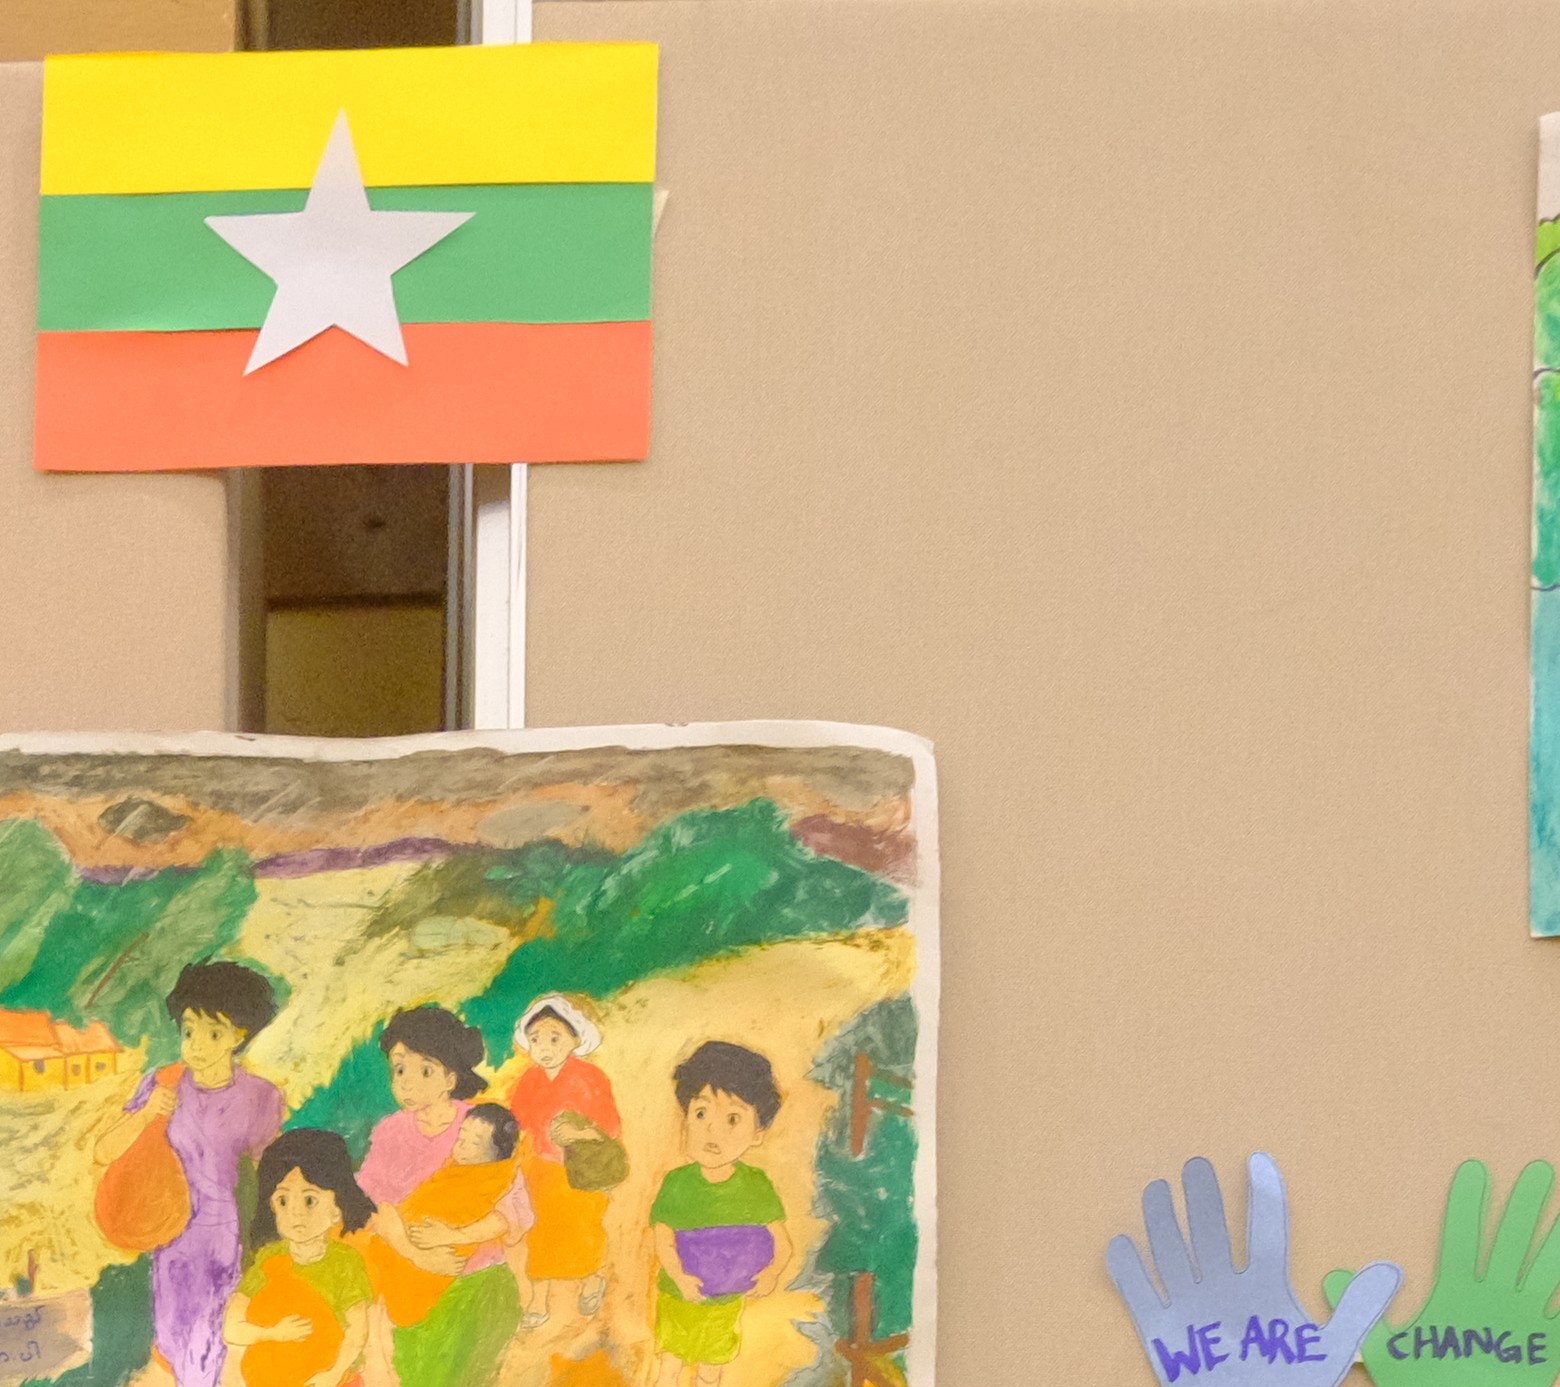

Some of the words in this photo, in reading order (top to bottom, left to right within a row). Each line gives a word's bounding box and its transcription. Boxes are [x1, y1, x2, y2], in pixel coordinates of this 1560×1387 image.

[1151, 1320, 1230, 1383] WE
[1238, 1314, 1328, 1366] ARE
[1386, 1324, 1550, 1366] CHANGE
